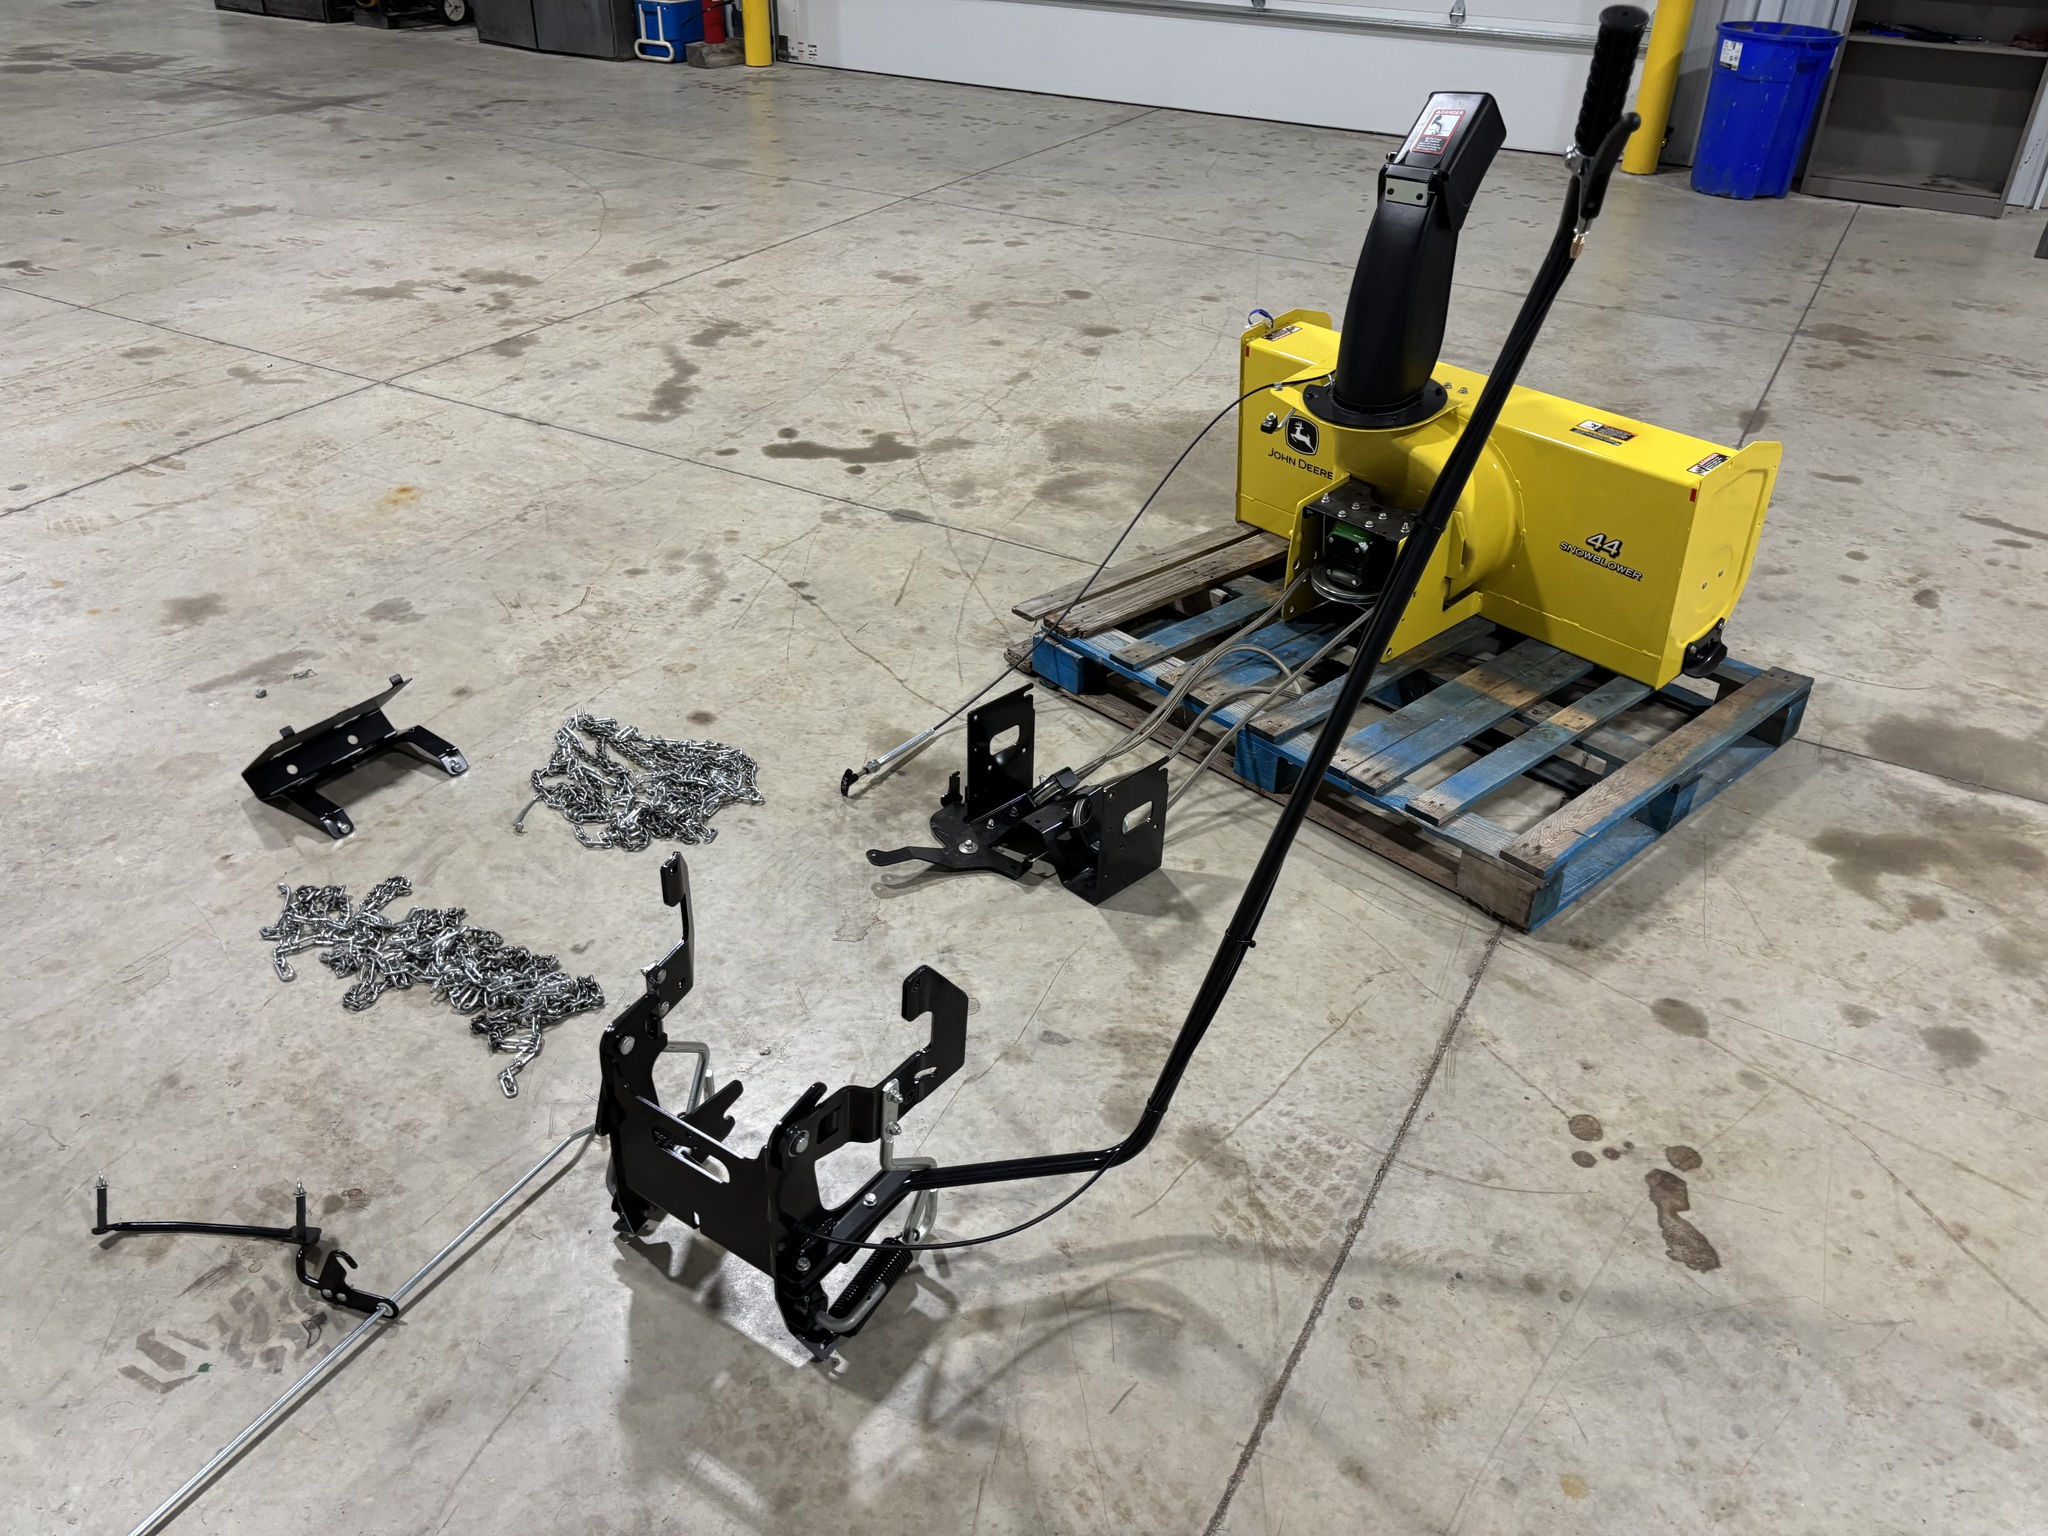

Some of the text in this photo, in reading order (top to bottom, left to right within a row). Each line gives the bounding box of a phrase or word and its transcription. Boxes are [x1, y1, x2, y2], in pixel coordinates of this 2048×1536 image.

[1267, 447, 1334, 480] JOHN DEERE
[1559, 541, 1643, 582] SNOWBLOWER
[1585, 532, 1623, 559] 44
